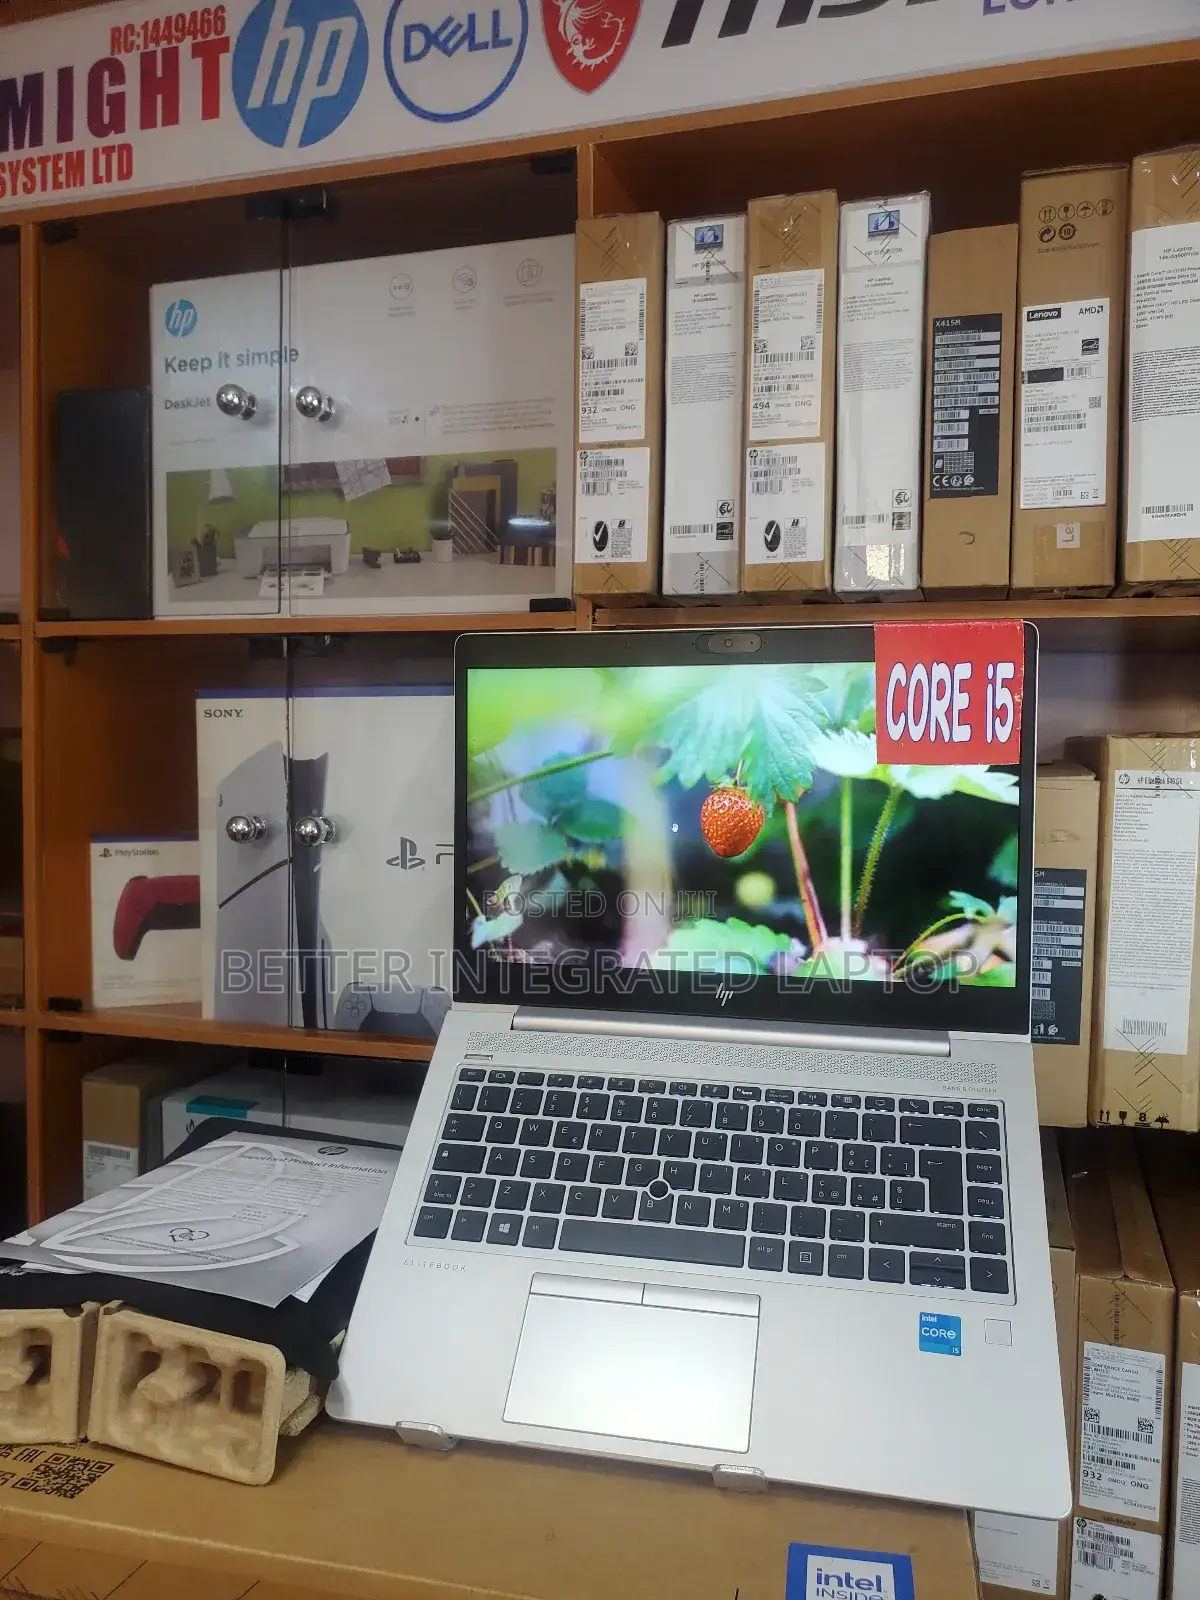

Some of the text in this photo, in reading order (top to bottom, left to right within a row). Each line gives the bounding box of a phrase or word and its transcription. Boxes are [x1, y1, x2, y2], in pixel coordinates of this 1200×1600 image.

[110, 5, 226, 55] RC:1449466
[403, 8, 513, 64] DELL
[0, 37, 230, 153] MIGHT
[92, 143, 133, 185] LTD
[166, 299, 198, 338] hp
[935, 319, 961, 327] X415M
[1029, 306, 1096, 320] Lenovo AMD
[164, 356, 212, 374] Keep
[236, 345, 300, 367] simple
[164, 397, 210, 410] DeskJet
[581, 406, 598, 414] 932
[753, 401, 770, 410] 494
[886, 661, 1016, 744] CORE i5
[204, 709, 243, 718] SONY
[115, 848, 159, 857] PlayStation
[714, 982, 734, 1007] hp
[238, 1153, 388, 1175] Important Product Information
[670, 1166, 678, 1174] H
[538, 1189, 546, 1197] X
[647, 1200, 653, 1208] B
[722, 1205, 731, 1213] M
[403, 1258, 466, 1272] ELITEBOOK
[922, 1314, 937, 1322] intel
[1082, 1470, 1102, 1481] 932
[1130, 1480, 1149, 1490] ONG
[816, 1568, 882, 1592] intel
